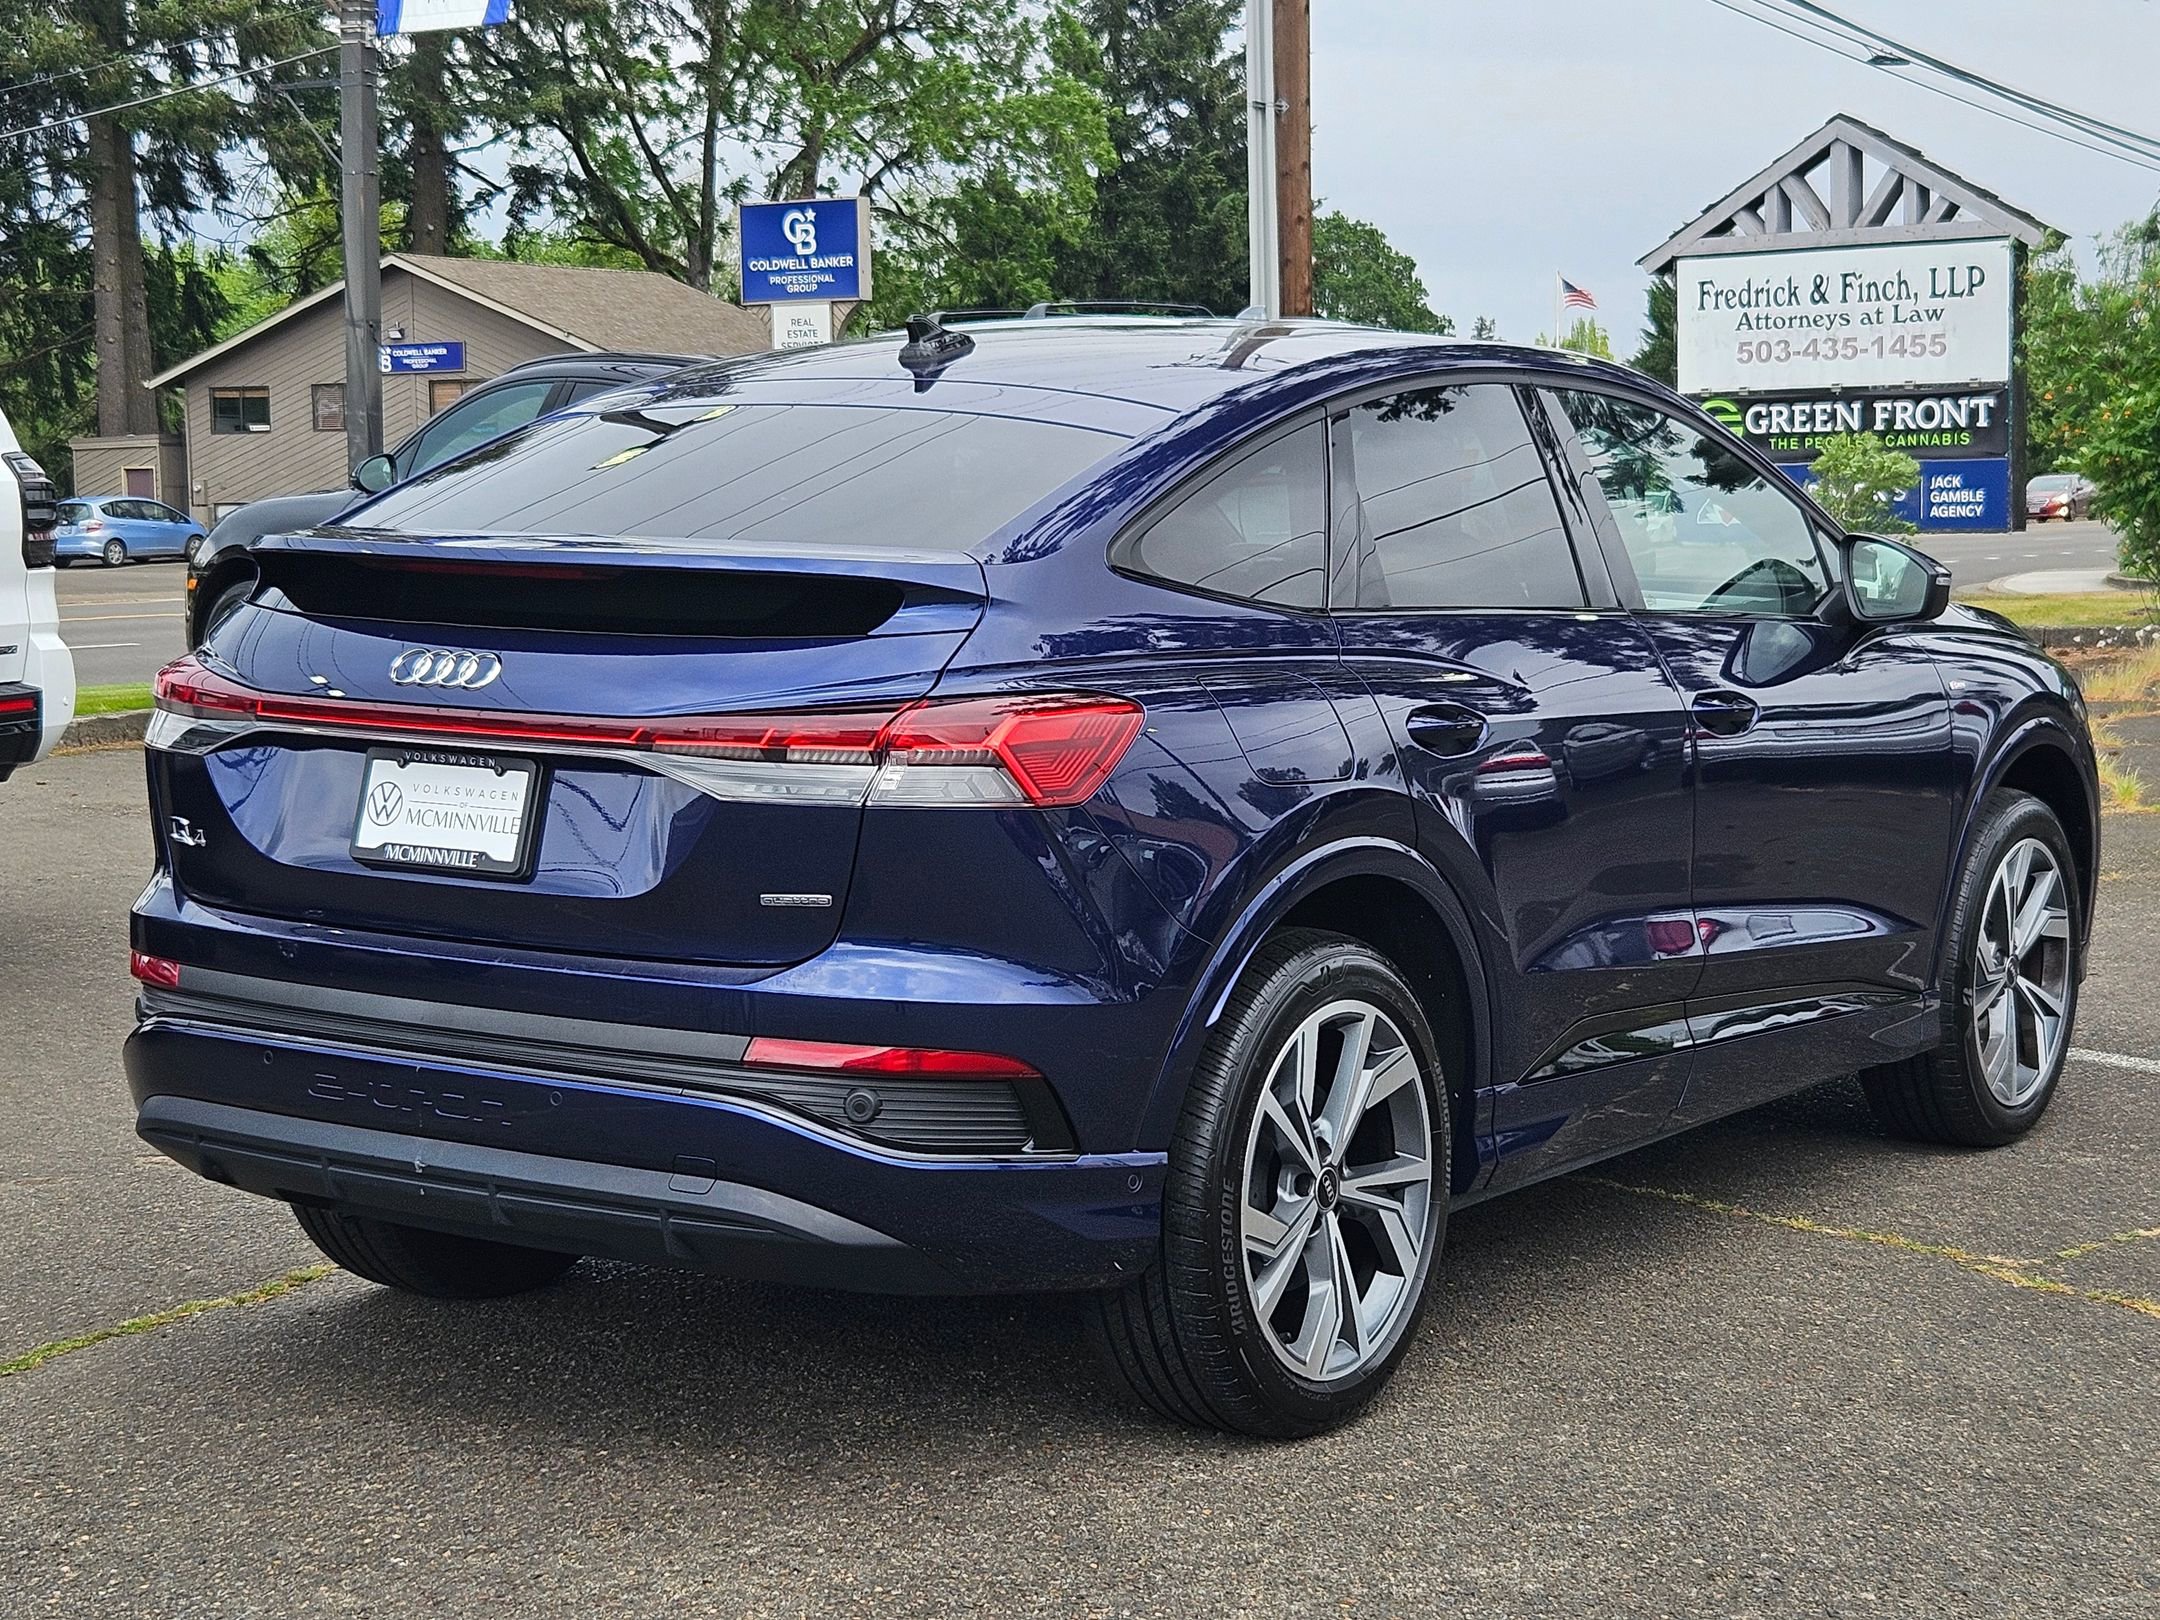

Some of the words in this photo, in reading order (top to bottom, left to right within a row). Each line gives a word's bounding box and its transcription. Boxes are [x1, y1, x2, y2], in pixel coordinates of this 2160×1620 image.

[749, 259, 808, 272] COLDWELL
[811, 255, 854, 269] BANKER
[769, 273, 836, 286] PROFESSIONAL
[786, 283, 818, 293] GROUP
[1697, 275, 1801, 311] Fredrick
[1809, 273, 1830, 305] &
[1840, 269, 1919, 304] Finch,
[1928, 265, 1986, 299] LLP
[790, 318, 815, 327] REAL
[1735, 308, 1851, 331] Attorneys
[1859, 306, 1885, 326] at
[1891, 303, 1945, 324] Law
[787, 329, 819, 338] ESTATE
[1736, 333, 1948, 365] 503-435-1455
[1745, 402, 1861, 434] GREEN
[1872, 397, 1996, 430] FRONT
[1769, 438, 1799, 450] THE
[1885, 432, 1971, 447] CANNABIS
[1930, 475, 1961, 489] JACK
[1930, 489, 1985, 502] GAMBLE
[1929, 504, 1983, 518] AGENCY
[405, 751, 497, 767] VOLKSWAGEN
[412, 783, 520, 801] VOLKSWAGEN
[405, 807, 522, 835] MCMINNVILLE
[385, 844, 480, 868] MCMINNVILLE
[1219, 1177, 1248, 1336] BRIDGESTONE
